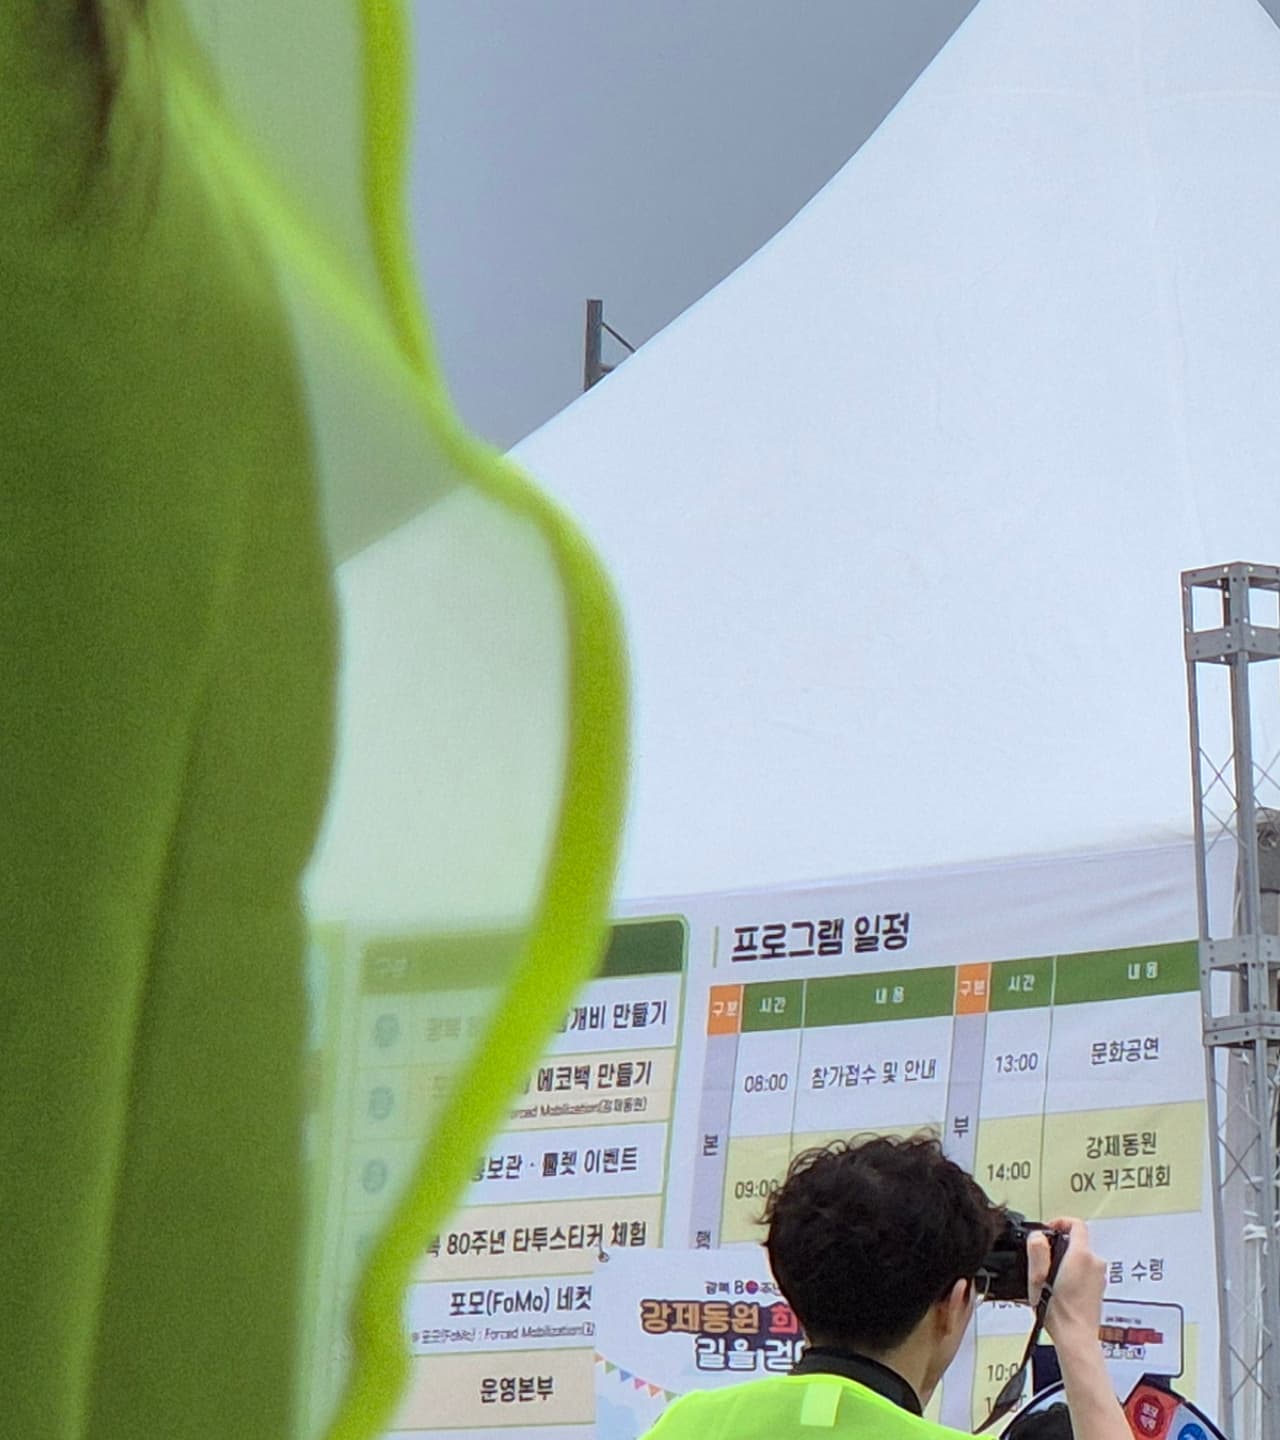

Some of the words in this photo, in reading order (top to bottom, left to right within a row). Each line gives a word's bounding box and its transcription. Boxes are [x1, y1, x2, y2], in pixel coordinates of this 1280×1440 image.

[731, 917, 845, 963] 프로그램
[853, 911, 911, 953] 일정
[712, 1000, 737, 1018] 구분
[758, 996, 787, 1015] 시간
[959, 979, 986, 998] 구분
[1007, 974, 1036, 993] 시간
[612, 1000, 668, 1030] 만들기
[537, 1065, 591, 1093] 에코백
[597, 1060, 653, 1089] 만들기
[743, 1072, 788, 1094] 08:00
[811, 1063, 877, 1091] 참가접수
[883, 1061, 898, 1083] 및
[904, 1058, 937, 1082] 안내
[995, 1052, 1039, 1074] 13:00
[1091, 1037, 1160, 1066] 문화공연
[953, 1116, 970, 1138] 부
[584, 1146, 638, 1174] 이벤트
[703, 1133, 719, 1157] 본
[1086, 1131, 1157, 1160] 강제동원
[986, 1160, 1032, 1182] 14:00
[1070, 1172, 1097, 1193] OX
[1102, 1165, 1171, 1192] 퀴즈대회
[446, 1229, 506, 1256] 80주년
[512, 1223, 604, 1253] 타투스티커
[611, 1220, 647, 1248] 체험
[1130, 1258, 1165, 1282] 수령
[450, 1285, 550, 1317] 포모(FoMo)
[556, 1284, 593, 1311] 네컷
[640, 1299, 761, 1335] 강제동원
[696, 1336, 757, 1371] 길을
[480, 1376, 553, 1404] 운영본부
